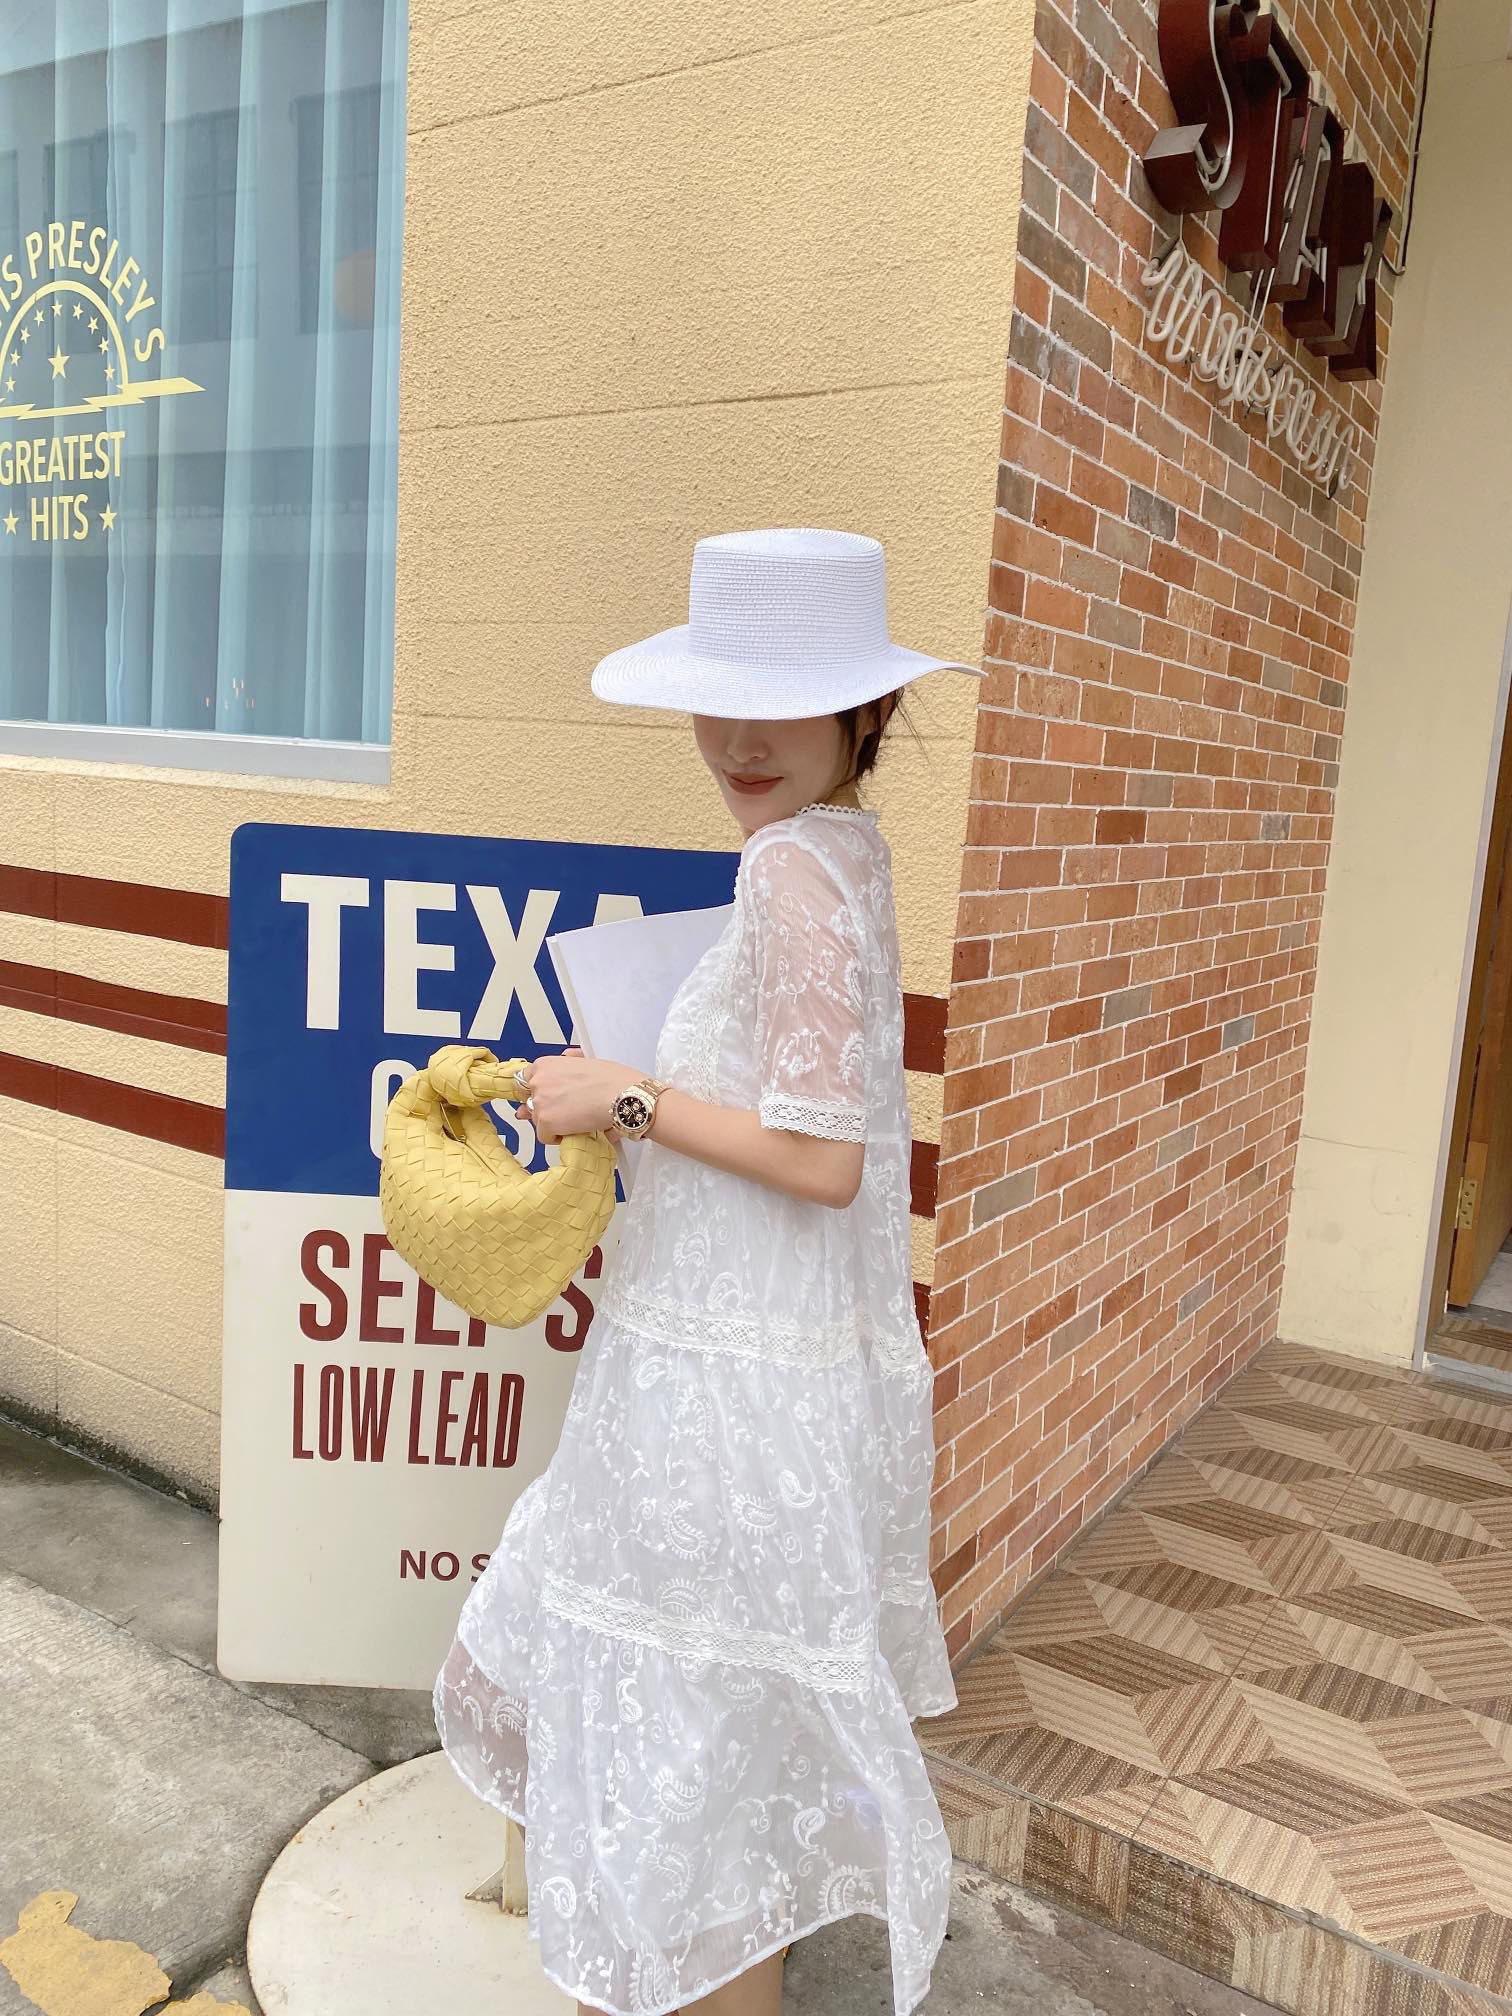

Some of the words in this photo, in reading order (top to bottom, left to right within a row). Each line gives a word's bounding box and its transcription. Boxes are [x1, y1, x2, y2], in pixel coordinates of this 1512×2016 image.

[0, 431, 125, 485] GREATEST
[31, 494, 89, 540] HITS
[280, 873, 646, 1046] TEX
[292, 1363, 396, 1463] LOW
[407, 1369, 525, 1468] LEAD
[400, 1549, 460, 1581] NO
